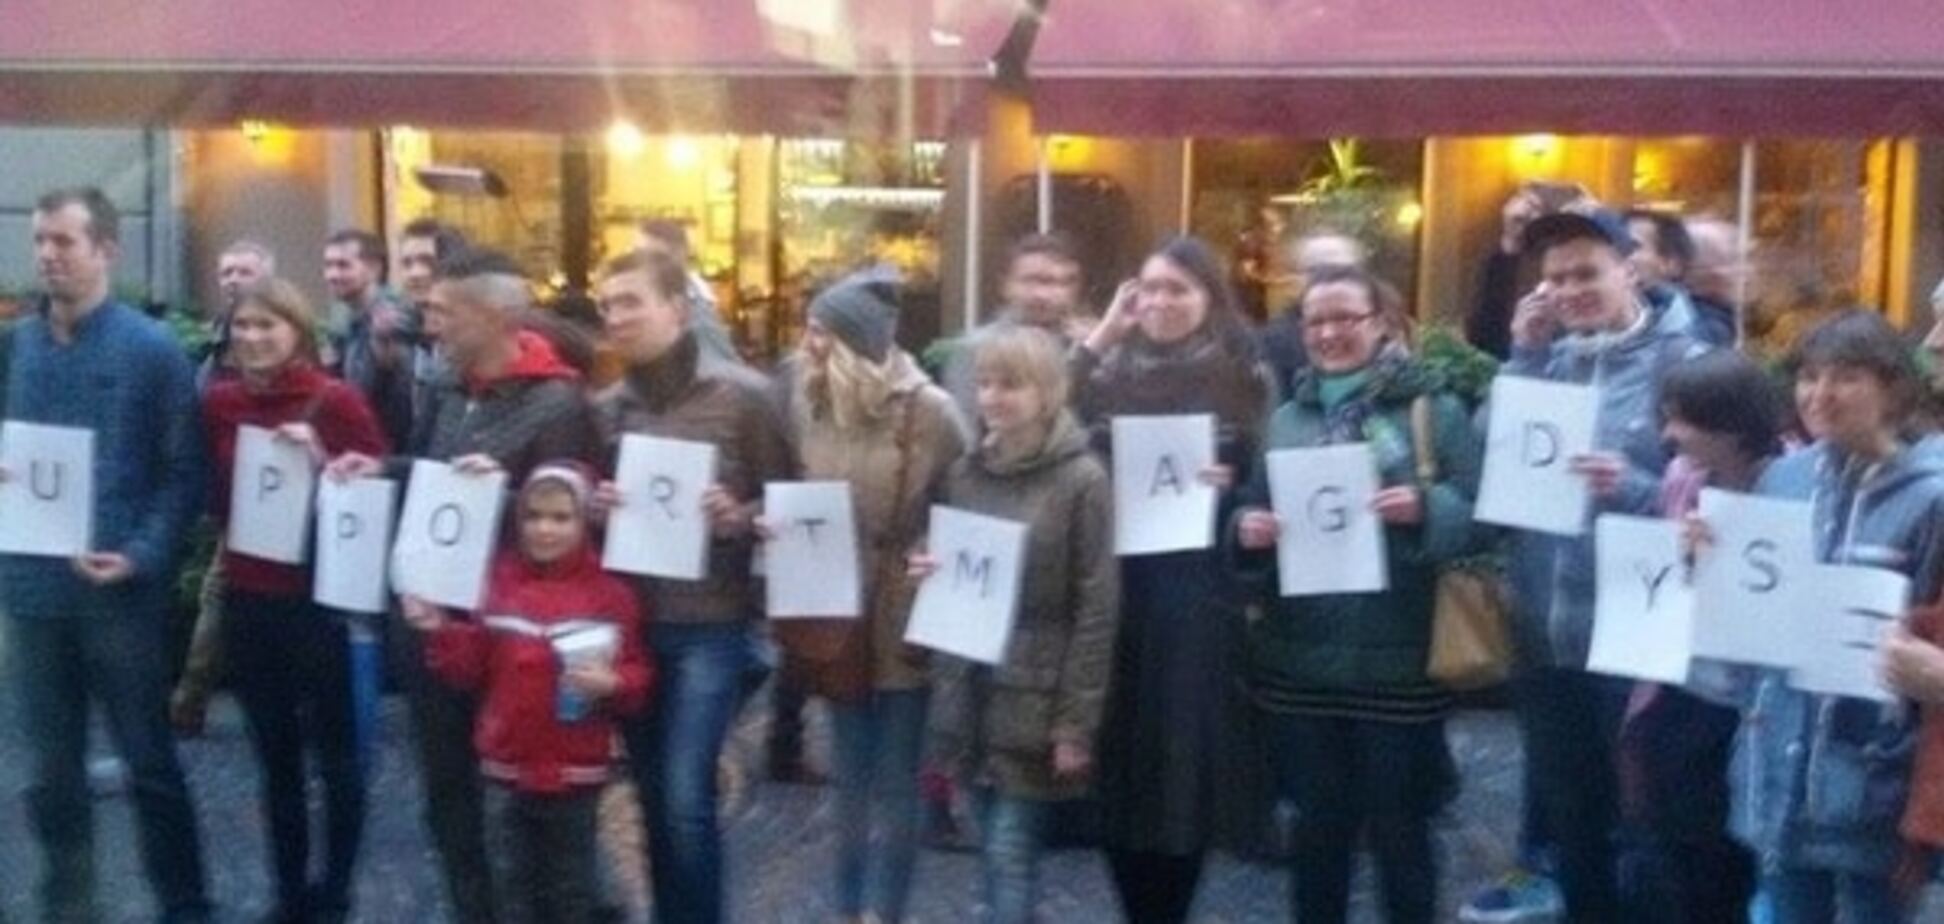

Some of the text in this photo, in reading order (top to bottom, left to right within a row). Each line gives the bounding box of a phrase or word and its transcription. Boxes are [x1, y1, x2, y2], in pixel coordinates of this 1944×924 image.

[1524, 421, 1562, 467] D
[30, 460, 61, 501] U
[258, 465, 283, 501] P
[649, 475, 678, 519] R
[1150, 455, 1184, 496] A
[429, 502, 464, 546] O
[1306, 485, 1348, 532] G
[795, 518, 827, 547] T
[954, 549, 993, 597] M
[1636, 561, 1671, 612] Y
[1740, 538, 1779, 592] S
